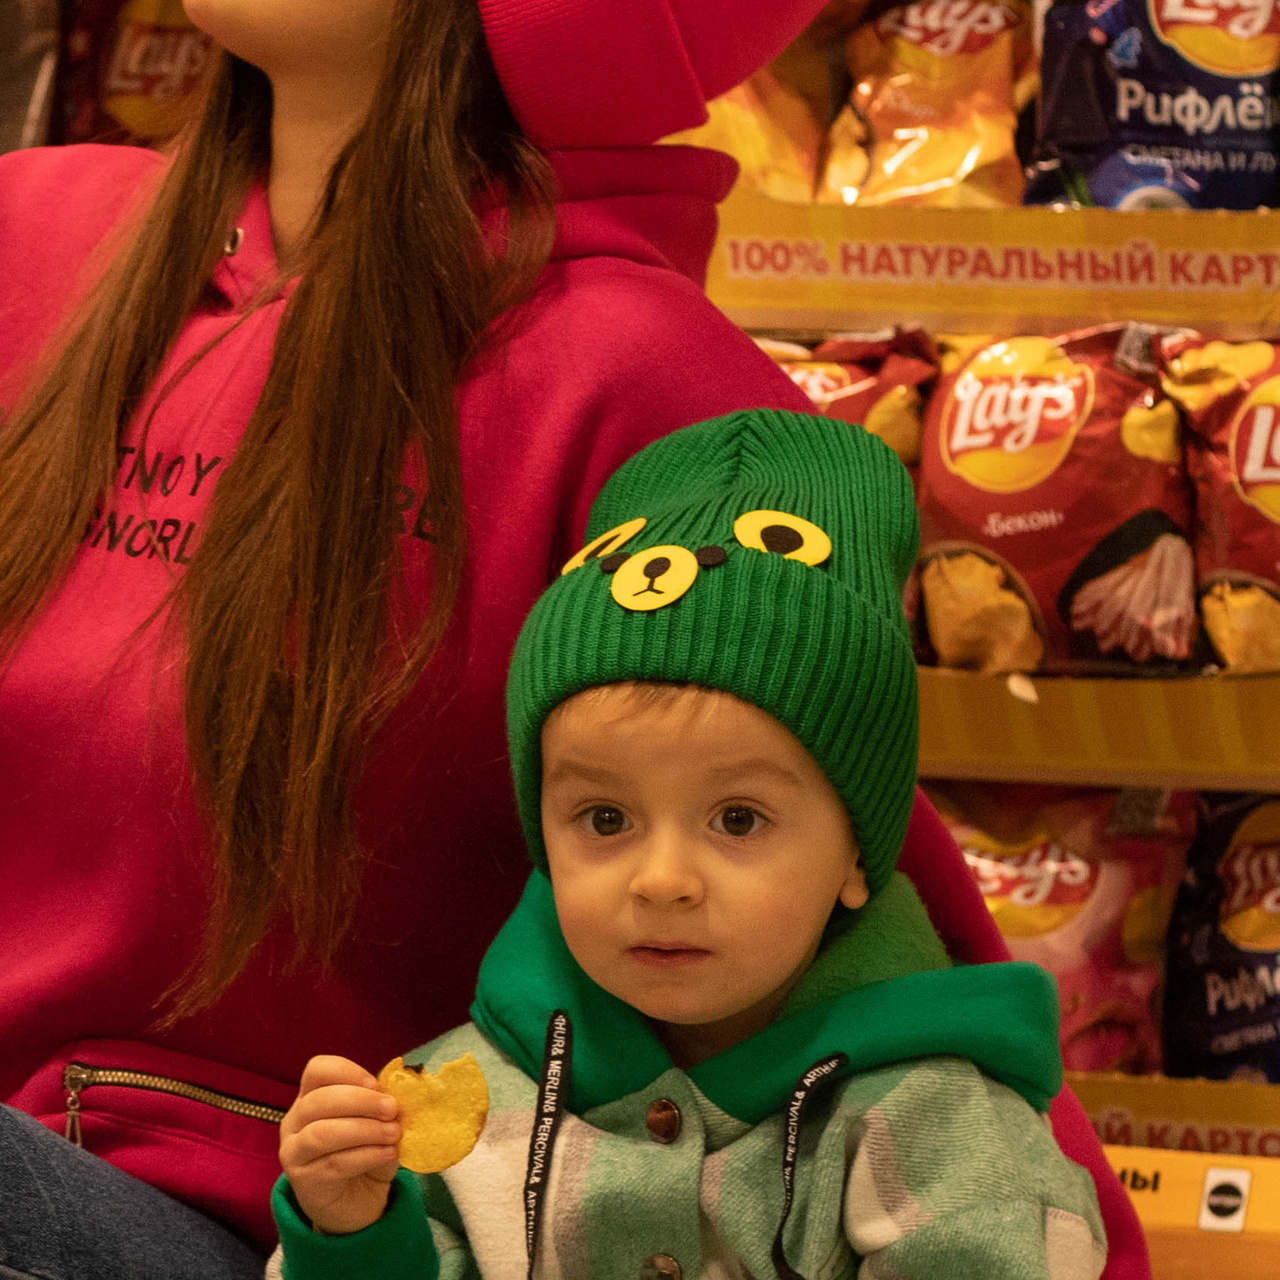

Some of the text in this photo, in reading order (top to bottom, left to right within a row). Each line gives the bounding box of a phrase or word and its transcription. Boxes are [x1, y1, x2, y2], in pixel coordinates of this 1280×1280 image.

[726, 238, 827, 278] 100%
[840, 241, 1156, 286] НАТУРАЛЬНЫЙ
[949, 372, 1085, 452] Lay's
